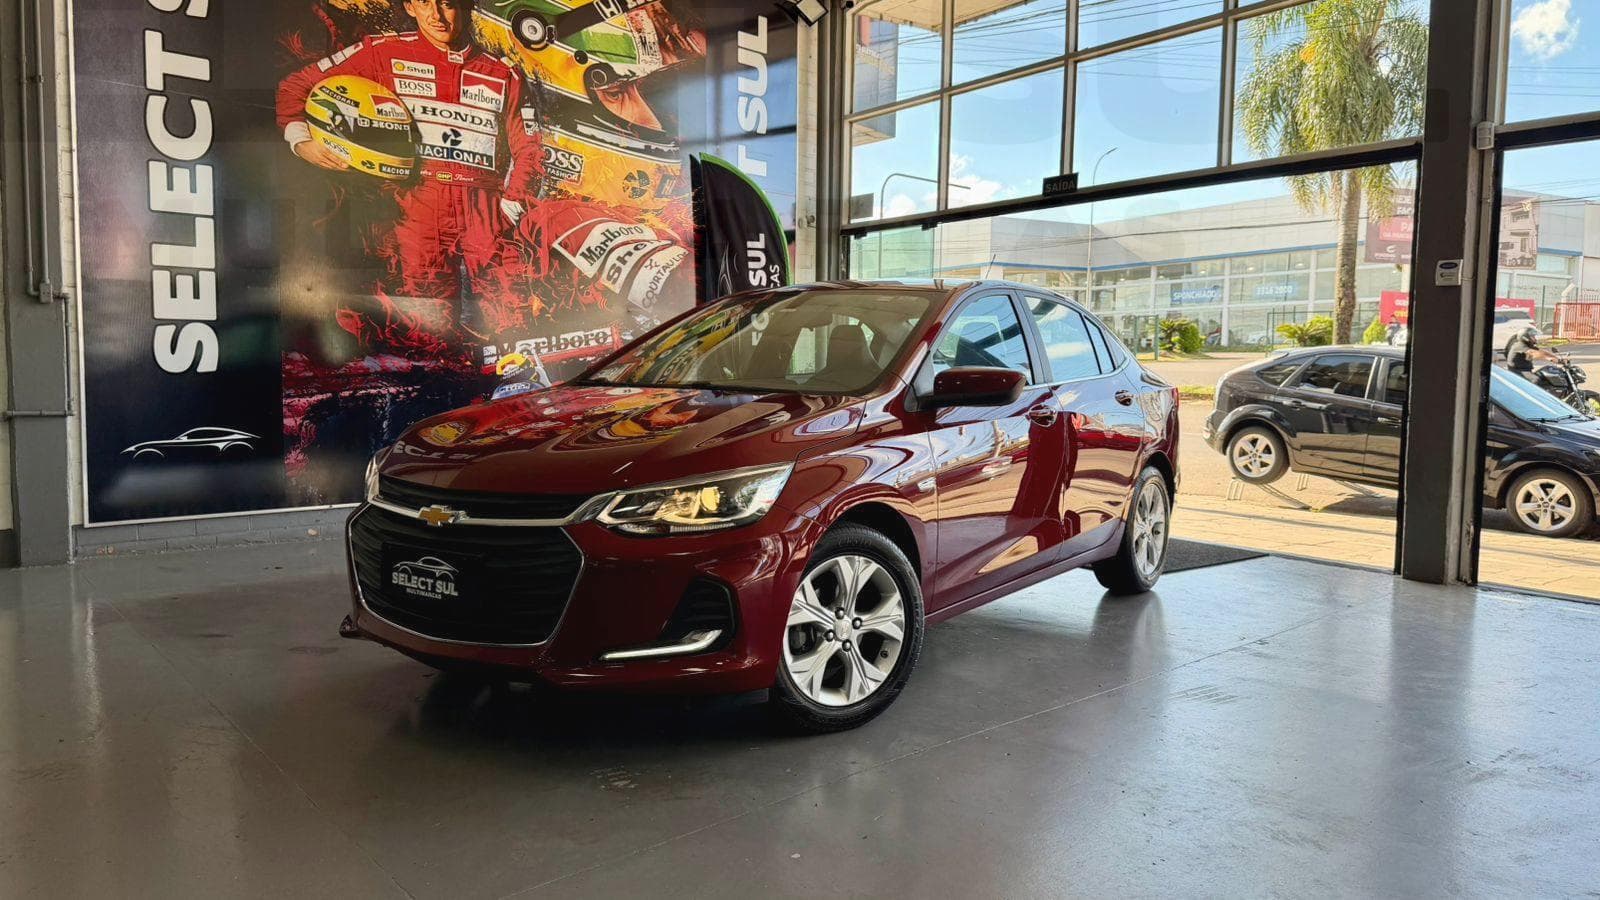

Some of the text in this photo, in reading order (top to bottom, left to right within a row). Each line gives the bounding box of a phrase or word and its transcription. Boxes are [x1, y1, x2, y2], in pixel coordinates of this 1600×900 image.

[407, 65, 434, 75] Shell
[738, 15, 768, 134] SUL
[398, 79, 433, 92] BOSS
[462, 88, 502, 106] Marlboro
[420, 105, 495, 129] HONDA
[144, 29, 220, 373] SELECT
[580, 225, 645, 267] Marlboro
[746, 233, 768, 288] SUL
[391, 571, 459, 597] SELECT SUL
